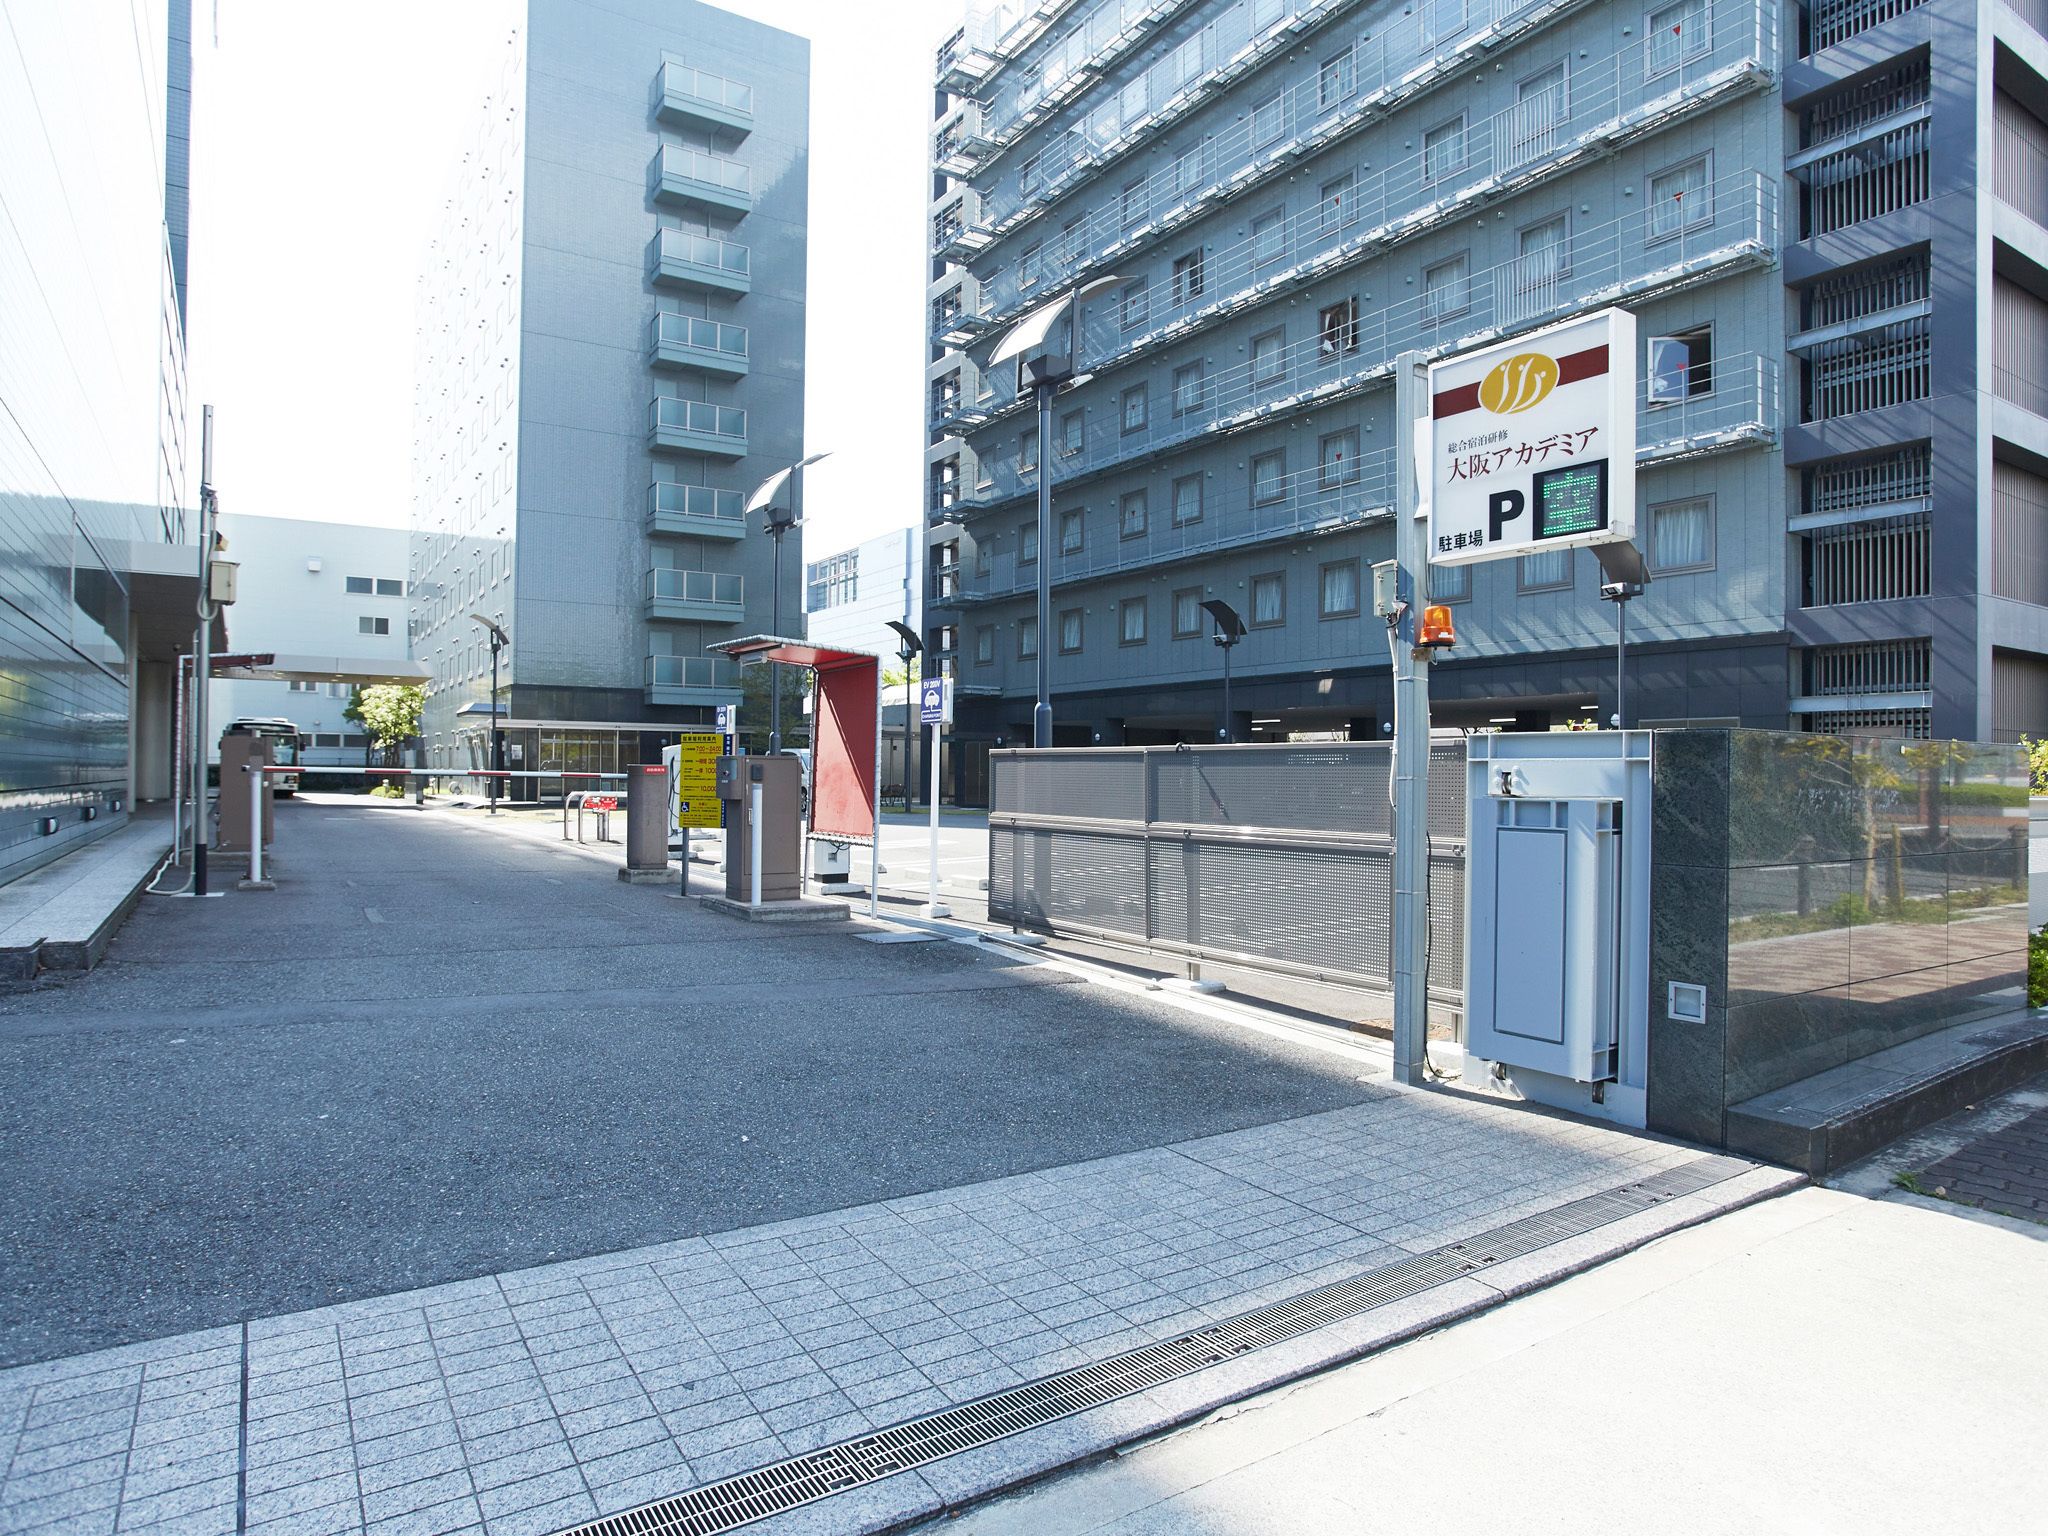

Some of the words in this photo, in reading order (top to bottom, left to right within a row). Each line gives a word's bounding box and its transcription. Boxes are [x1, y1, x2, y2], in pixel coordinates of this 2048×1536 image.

[1447, 426, 1599, 484] 大阪アカデミア
[1448, 429, 1508, 454] 総合宿泊研修
[1488, 489, 1525, 542] P
[1438, 529, 1483, 553] 駐車場
